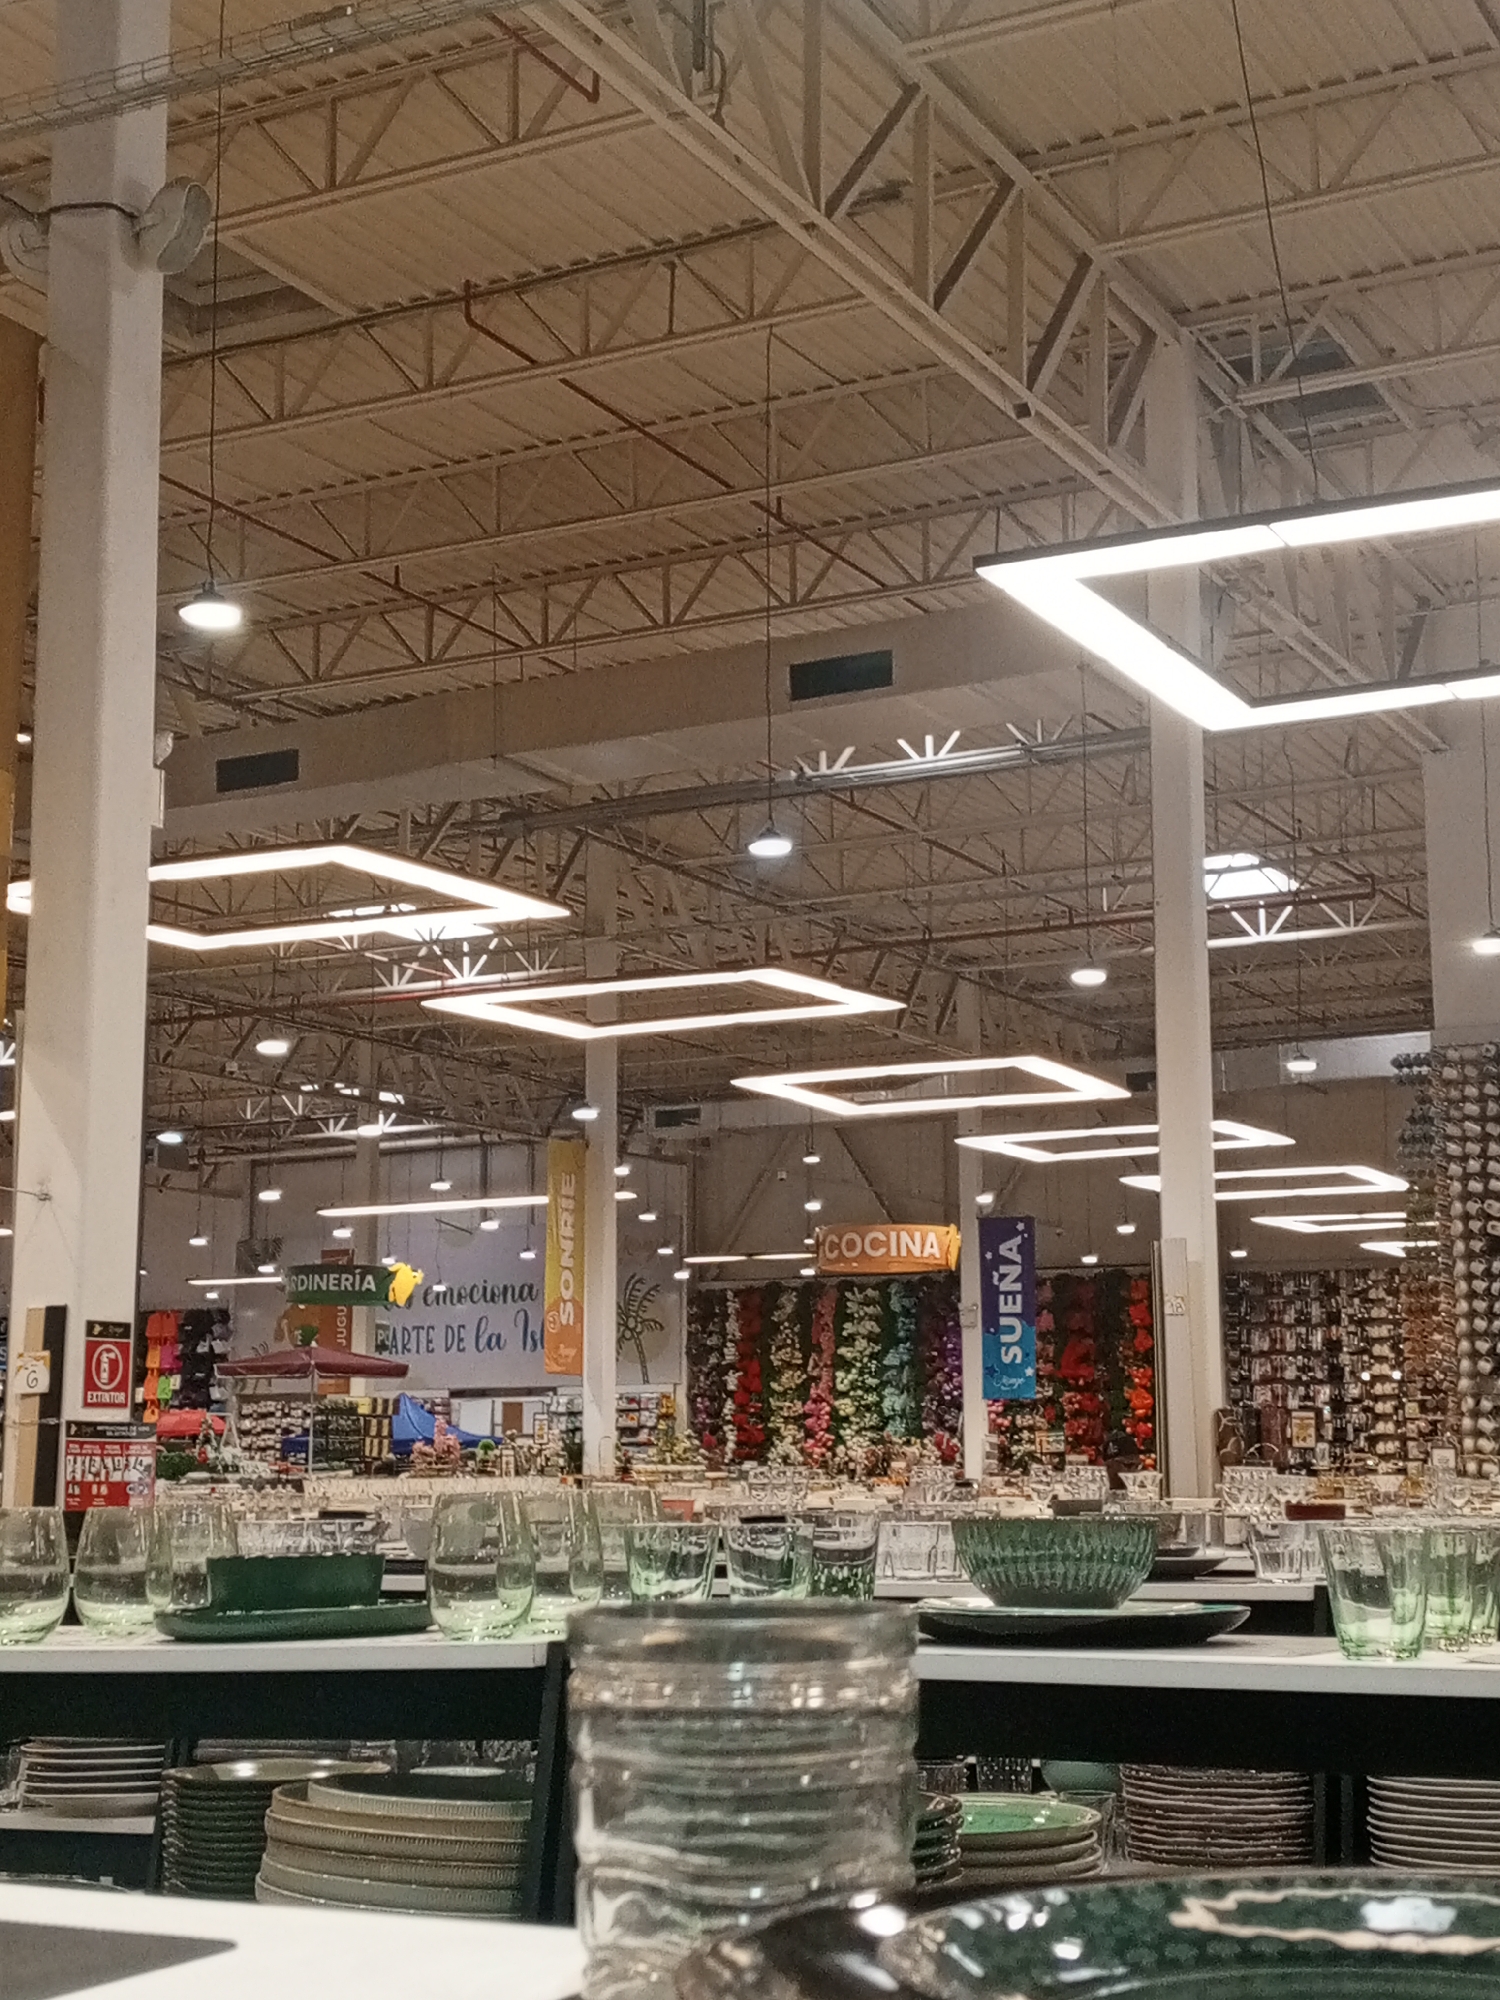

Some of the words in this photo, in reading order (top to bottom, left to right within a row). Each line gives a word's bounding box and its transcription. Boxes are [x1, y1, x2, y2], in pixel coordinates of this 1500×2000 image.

[560, 1173, 576, 1326] SONRIE
[824, 1230, 941, 1259] COCINA
[287, 1269, 376, 1292] RDINERÍA
[423, 1279, 539, 1307] emociona
[993, 1235, 1022, 1364] SUEÑA
[384, 1325, 435, 1355] ARTE
[445, 1324, 466, 1353] DE
[475, 1315, 507, 1353] la
[87, 1391, 126, 1404] EXTINTOR
